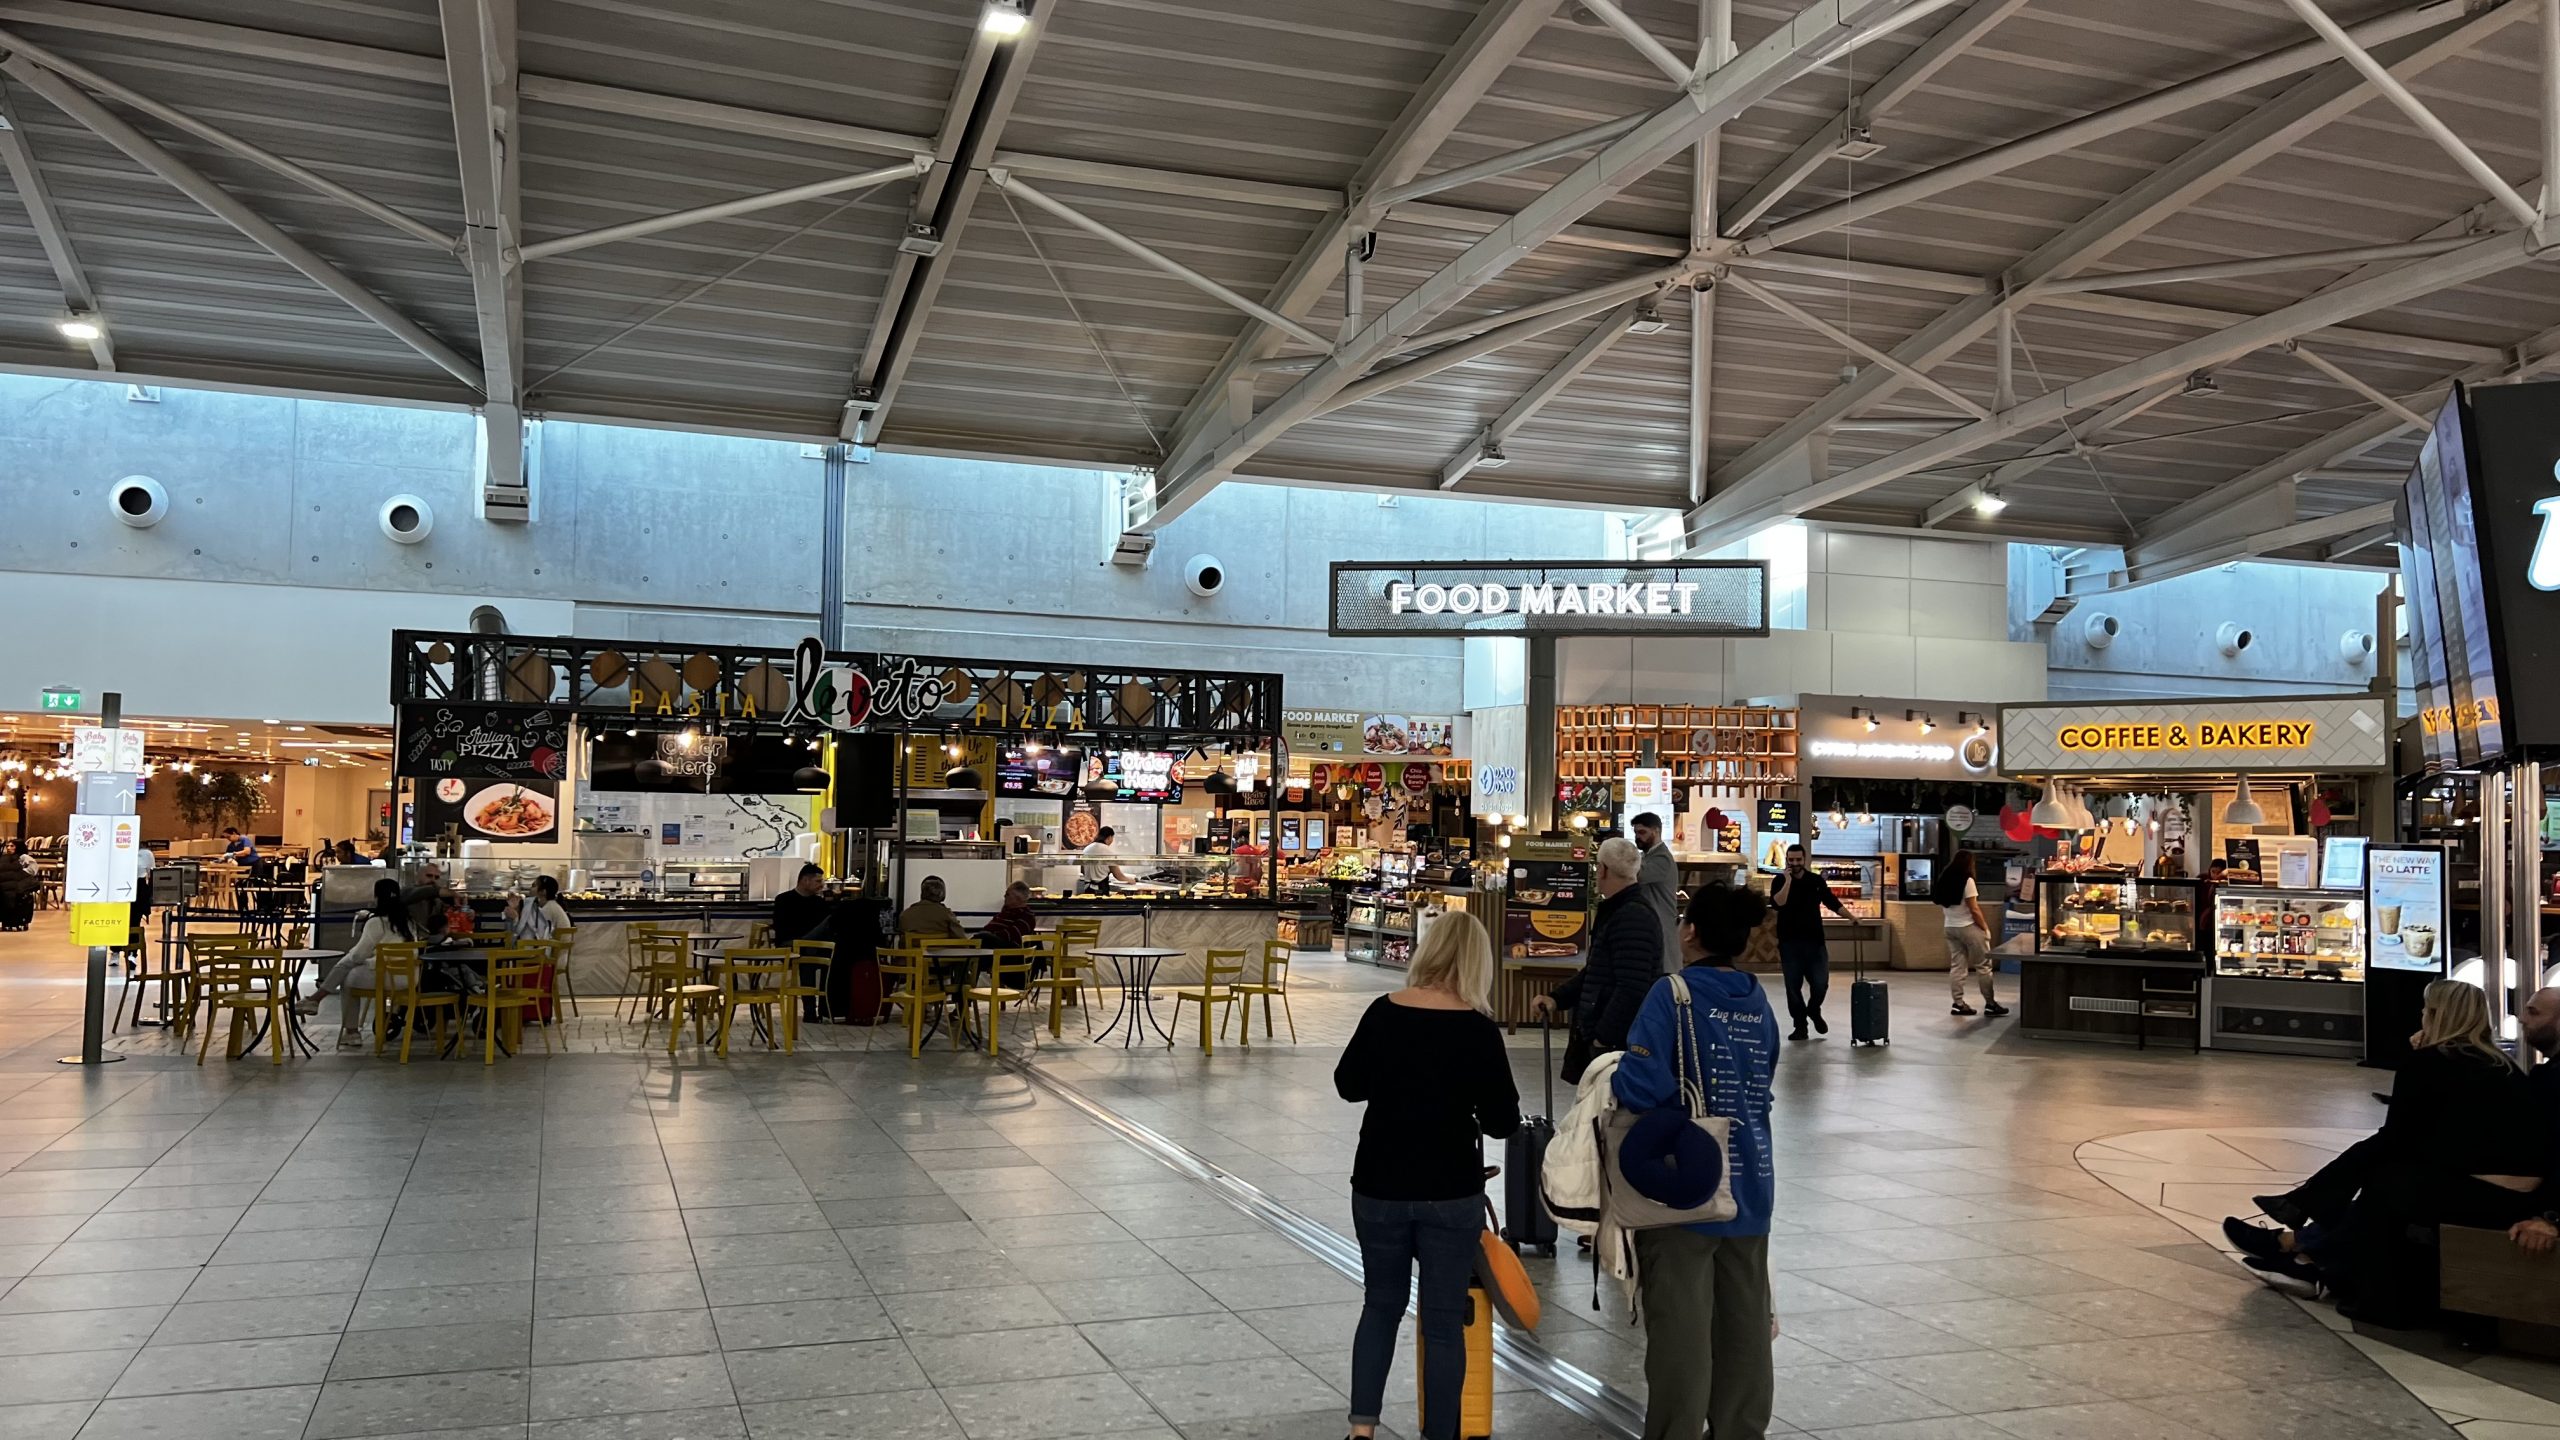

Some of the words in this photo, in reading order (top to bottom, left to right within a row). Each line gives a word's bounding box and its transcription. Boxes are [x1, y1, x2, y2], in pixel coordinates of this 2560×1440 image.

[1391, 582, 1510, 614] FOOD
[1519, 582, 1699, 614] MARKET
[781, 637, 957, 727] levito
[630, 689, 757, 718] PASTA
[975, 703, 1085, 731] PIZZA
[1282, 711, 1312, 722] FOOD
[1314, 712, 1360, 723] MARKET
[465, 726, 513, 745] Italian
[2060, 726, 2160, 748] COFFEE
[2169, 726, 2189, 746] &
[2201, 723, 2312, 746] BAKERY
[459, 743, 519, 760] PIZZA
[430, 759, 454, 771] TASTY
[666, 757, 717, 776] Here
[1121, 751, 1173, 772] Order
[1123, 770, 1168, 790] Here
[443, 787, 450, 796] 5
[2380, 865, 2393, 873] TO
[2396, 866, 2431, 874] LATTE
[1709, 1008, 1729, 1023] Zug
